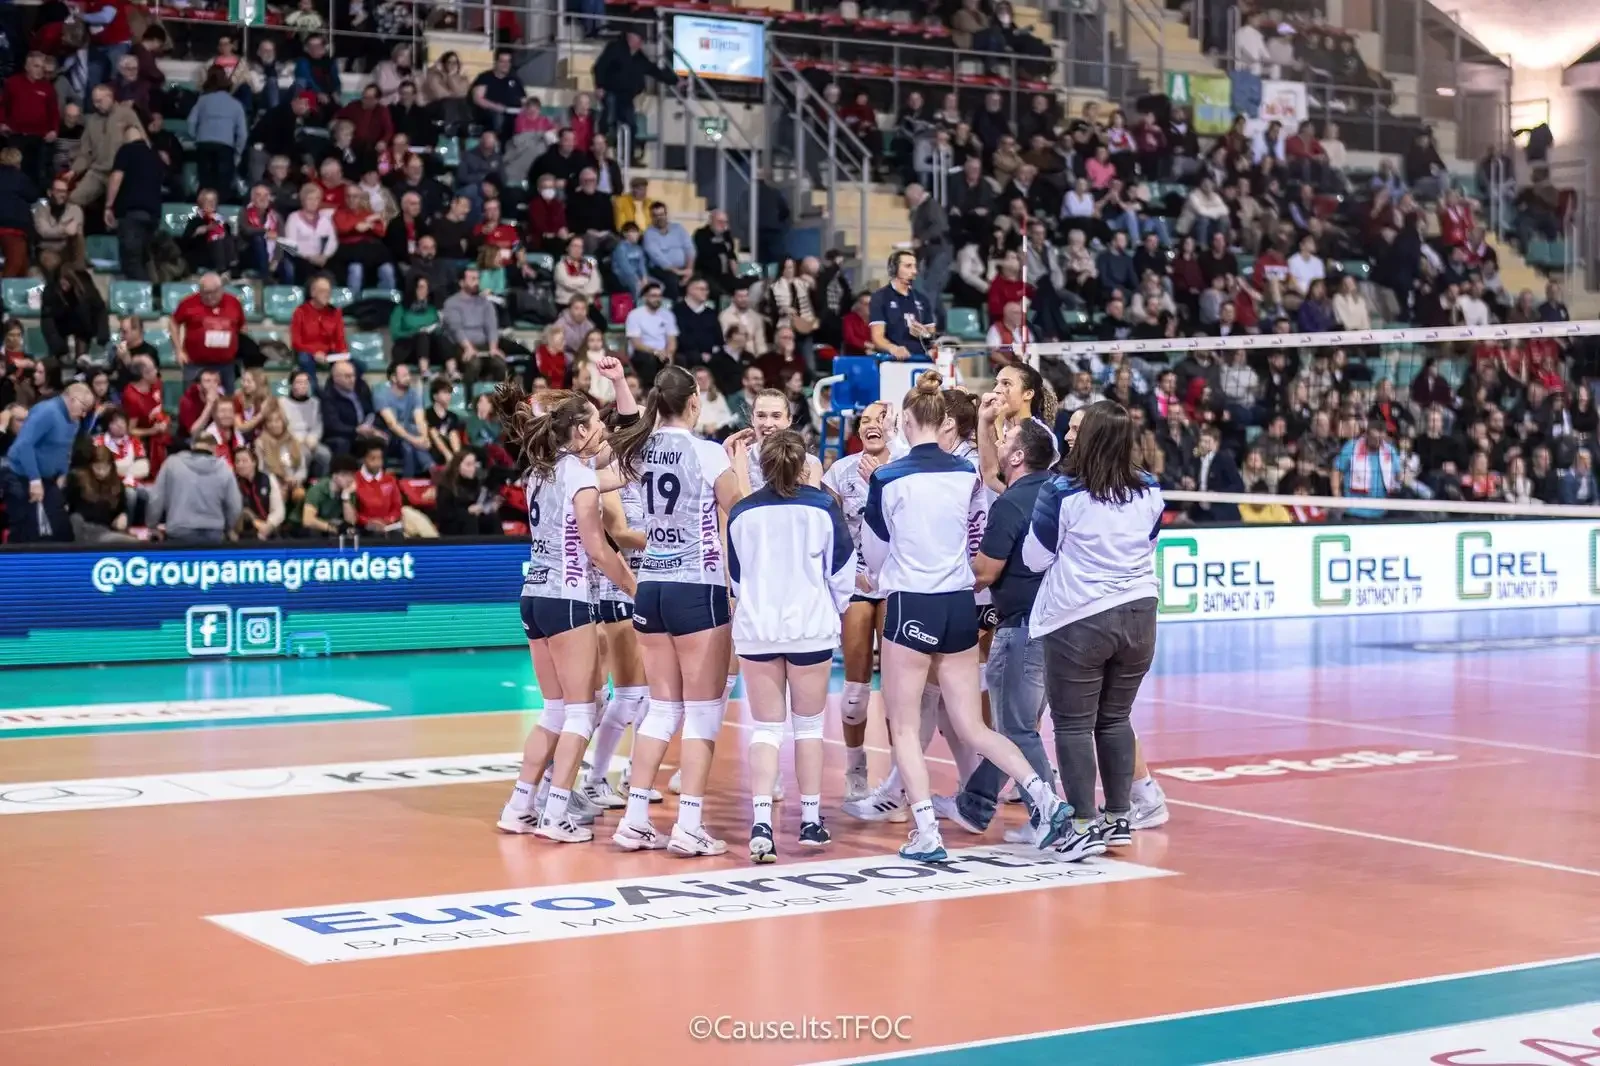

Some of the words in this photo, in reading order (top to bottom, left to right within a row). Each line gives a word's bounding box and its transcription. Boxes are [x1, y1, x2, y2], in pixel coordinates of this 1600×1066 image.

[641, 472, 681, 516] 19
[92, 551, 415, 593] @Groupamagrandest
[1311, 534, 1422, 606] COREL
[1456, 531, 1558, 600] COREL
[1153, 750, 1458, 782] Betclic
[343, 928, 531, 950] BASEL
[559, 893, 853, 929] MULHOUSE
